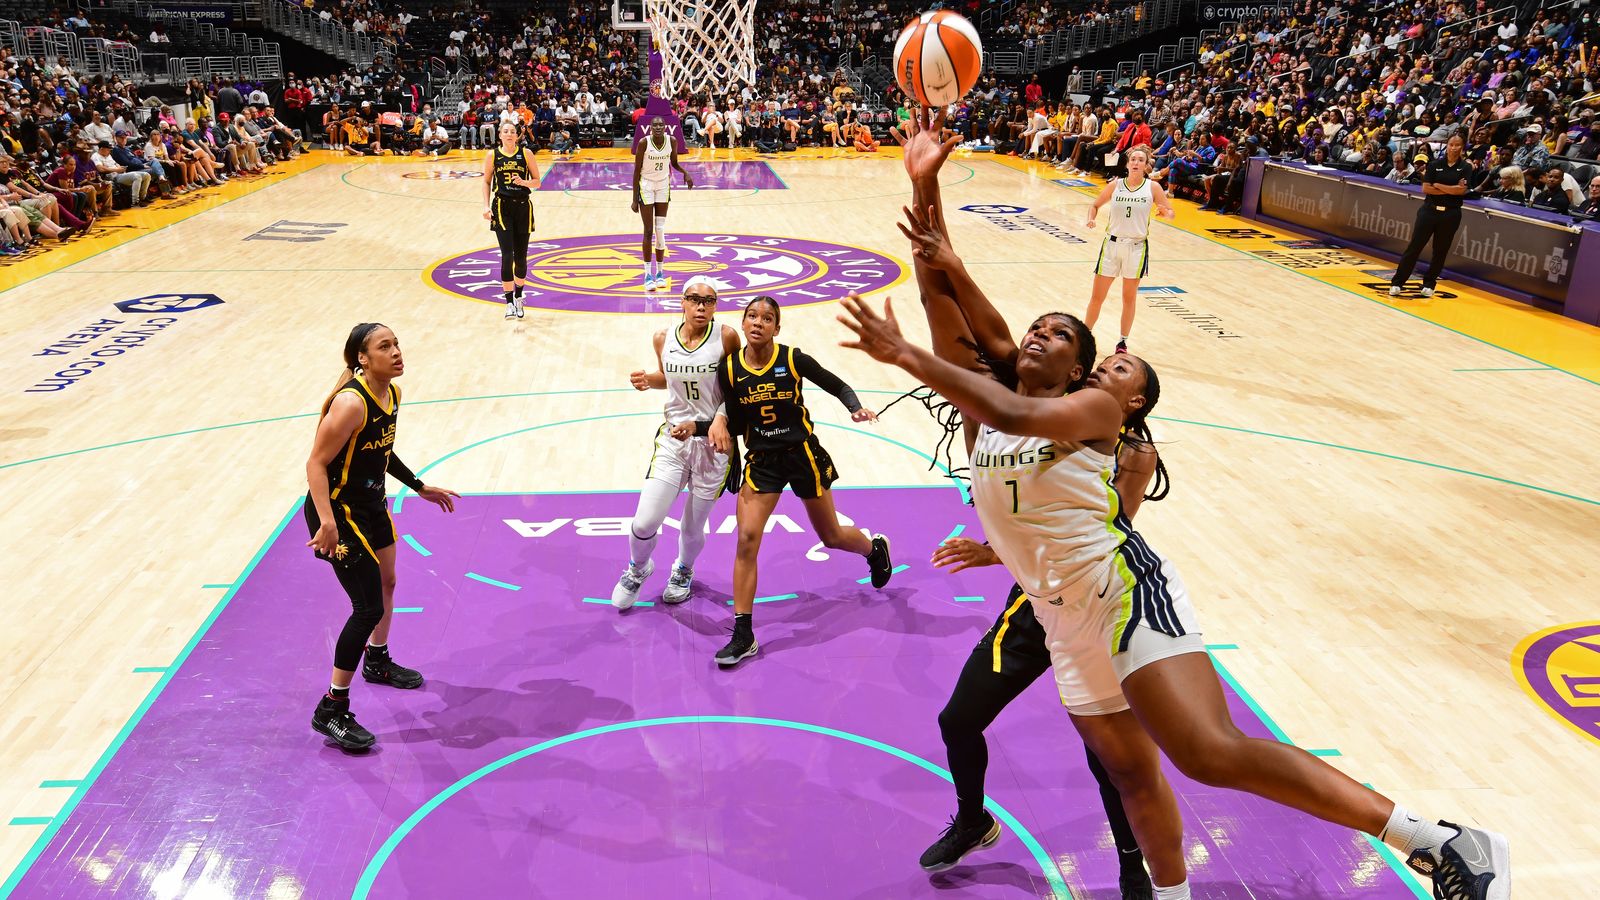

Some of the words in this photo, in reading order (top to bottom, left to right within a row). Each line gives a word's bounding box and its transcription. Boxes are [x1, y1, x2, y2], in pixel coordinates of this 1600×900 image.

[190, 11, 226, 19] EXPRESS
[1217, 6, 1290, 19] cryptocom
[655, 162, 664, 171] 28
[1271, 180, 1317, 216] Anthem
[1126, 206, 1132, 218] 3
[1348, 199, 1412, 242] Anthem
[1453, 225, 1538, 278] Anthem
[32, 318, 126, 357] ARENA
[24, 317, 178, 392] crypto.com
[666, 362, 718, 374] WINGS
[683, 381, 700, 400] 15
[748, 383, 776, 394] LOS
[739, 391, 793, 405] ANGELES
[761, 405, 777, 424] 5
[382, 423, 396, 437] LOS
[976, 444, 1056, 468] WINGS
